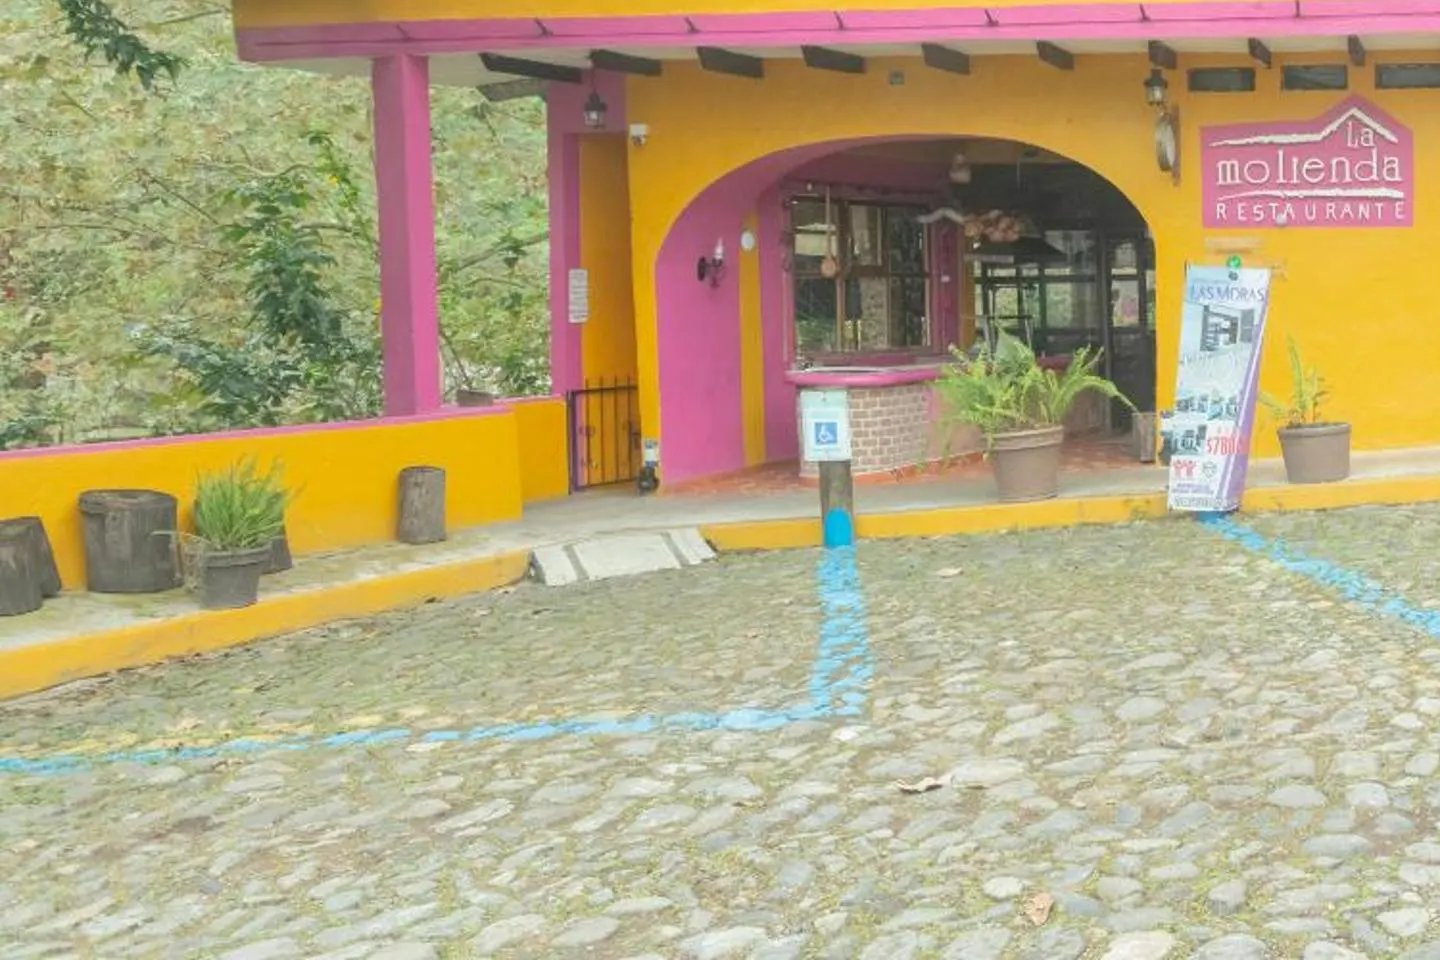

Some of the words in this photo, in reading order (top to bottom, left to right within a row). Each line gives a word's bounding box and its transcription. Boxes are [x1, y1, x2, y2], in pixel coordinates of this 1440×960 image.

[1346, 121, 1376, 148] La
[1216, 148, 1404, 186] molienda
[1215, 201, 1405, 222] RESTAURANTE
